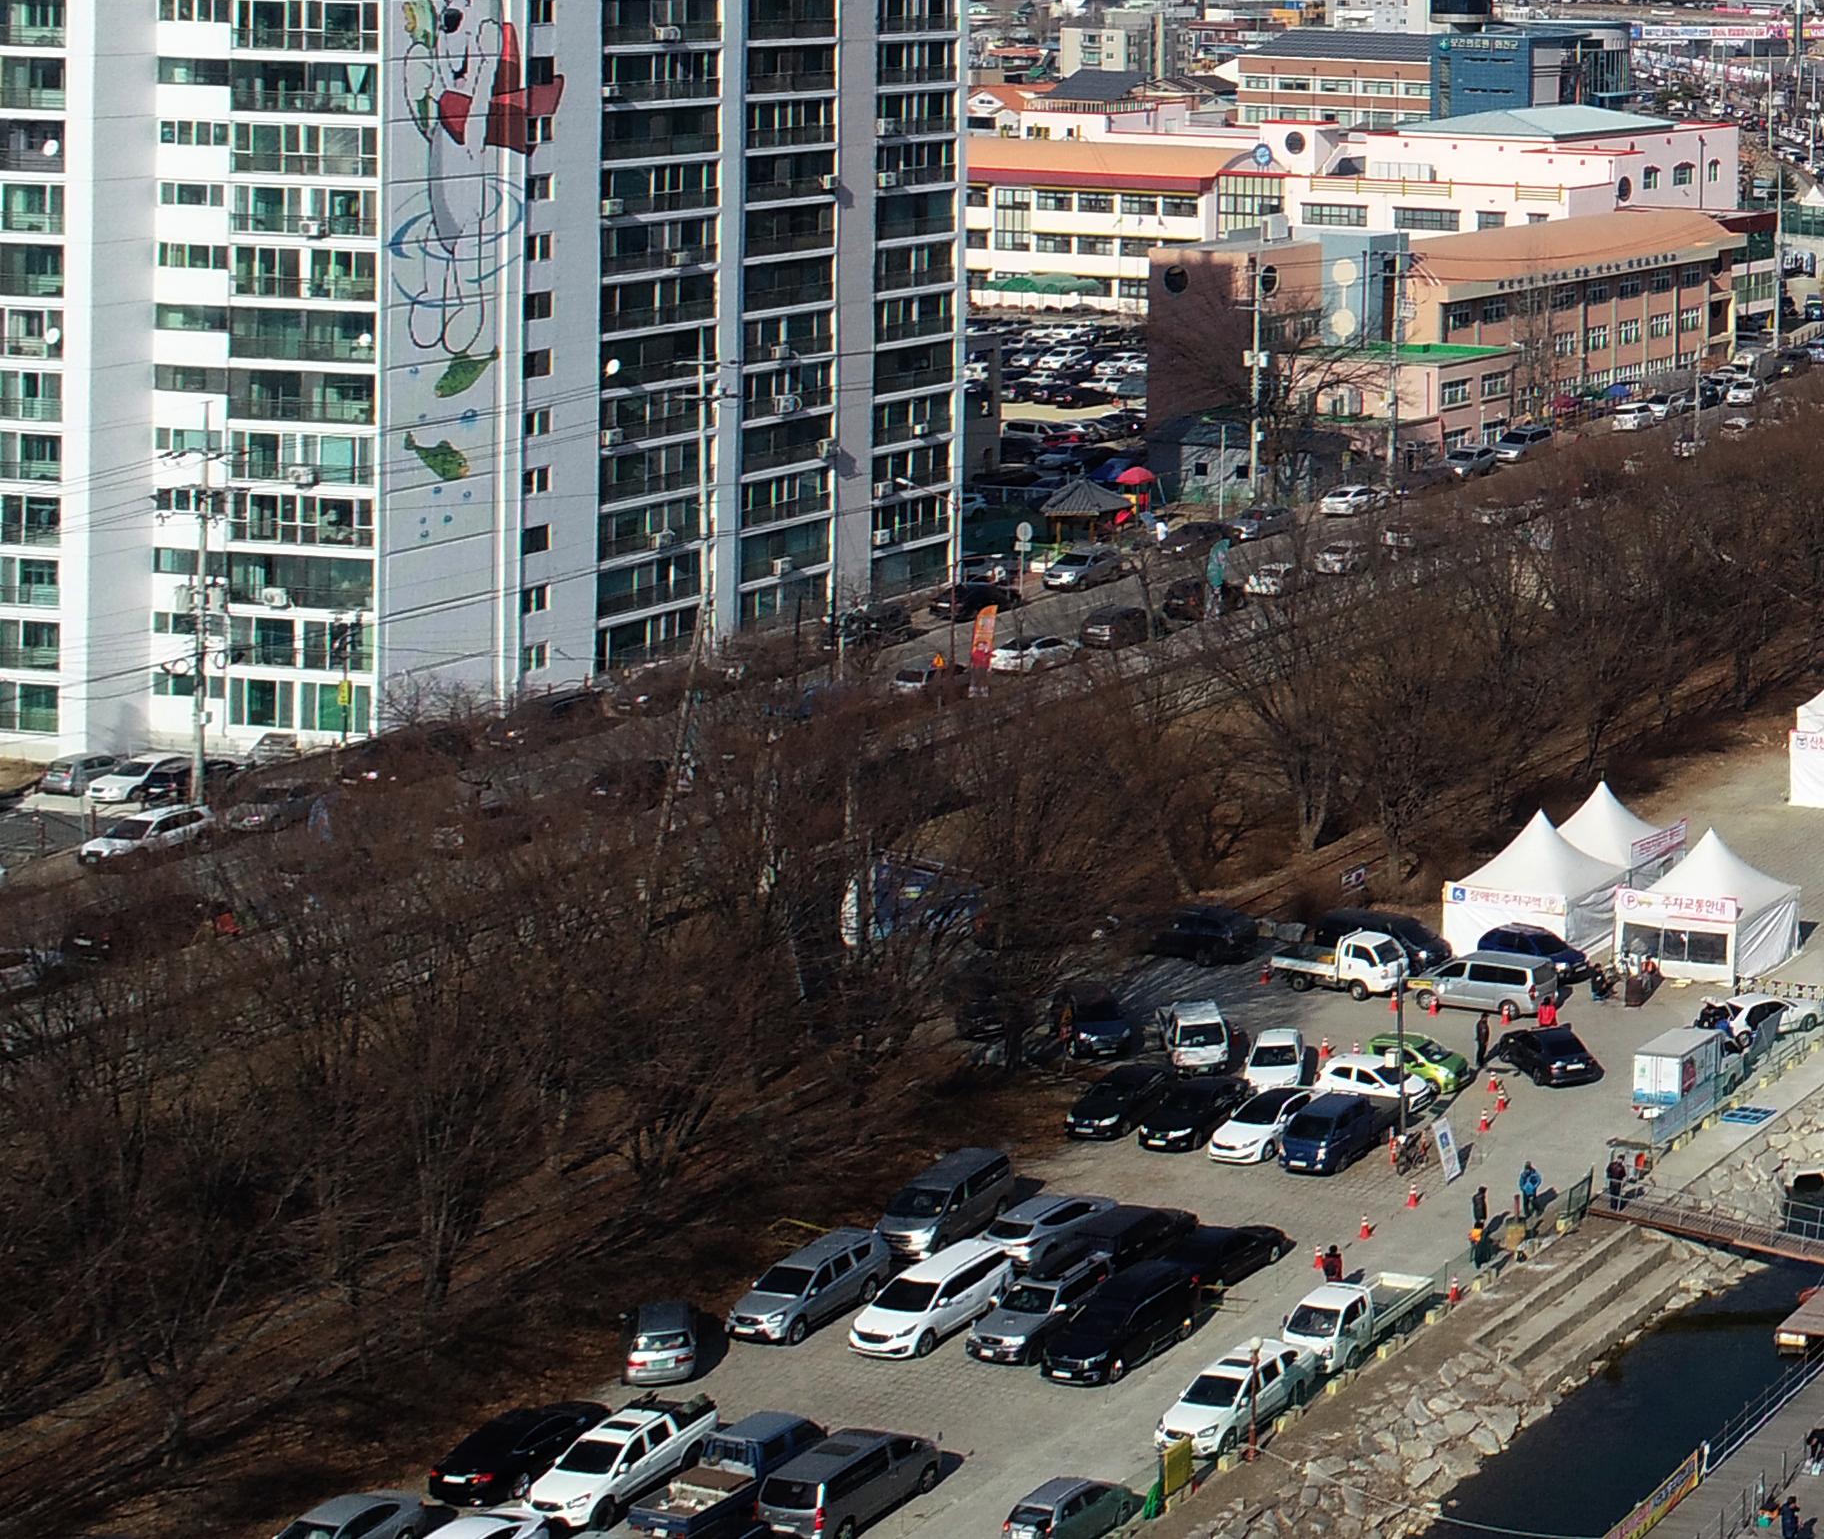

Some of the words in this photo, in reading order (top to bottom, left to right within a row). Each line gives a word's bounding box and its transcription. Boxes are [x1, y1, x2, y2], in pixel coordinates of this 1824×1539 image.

[1470, 890, 1501, 905] 장애인
[1501, 893, 1542, 908] 주차구역
[1662, 896, 1726, 915] 주차교통안내
